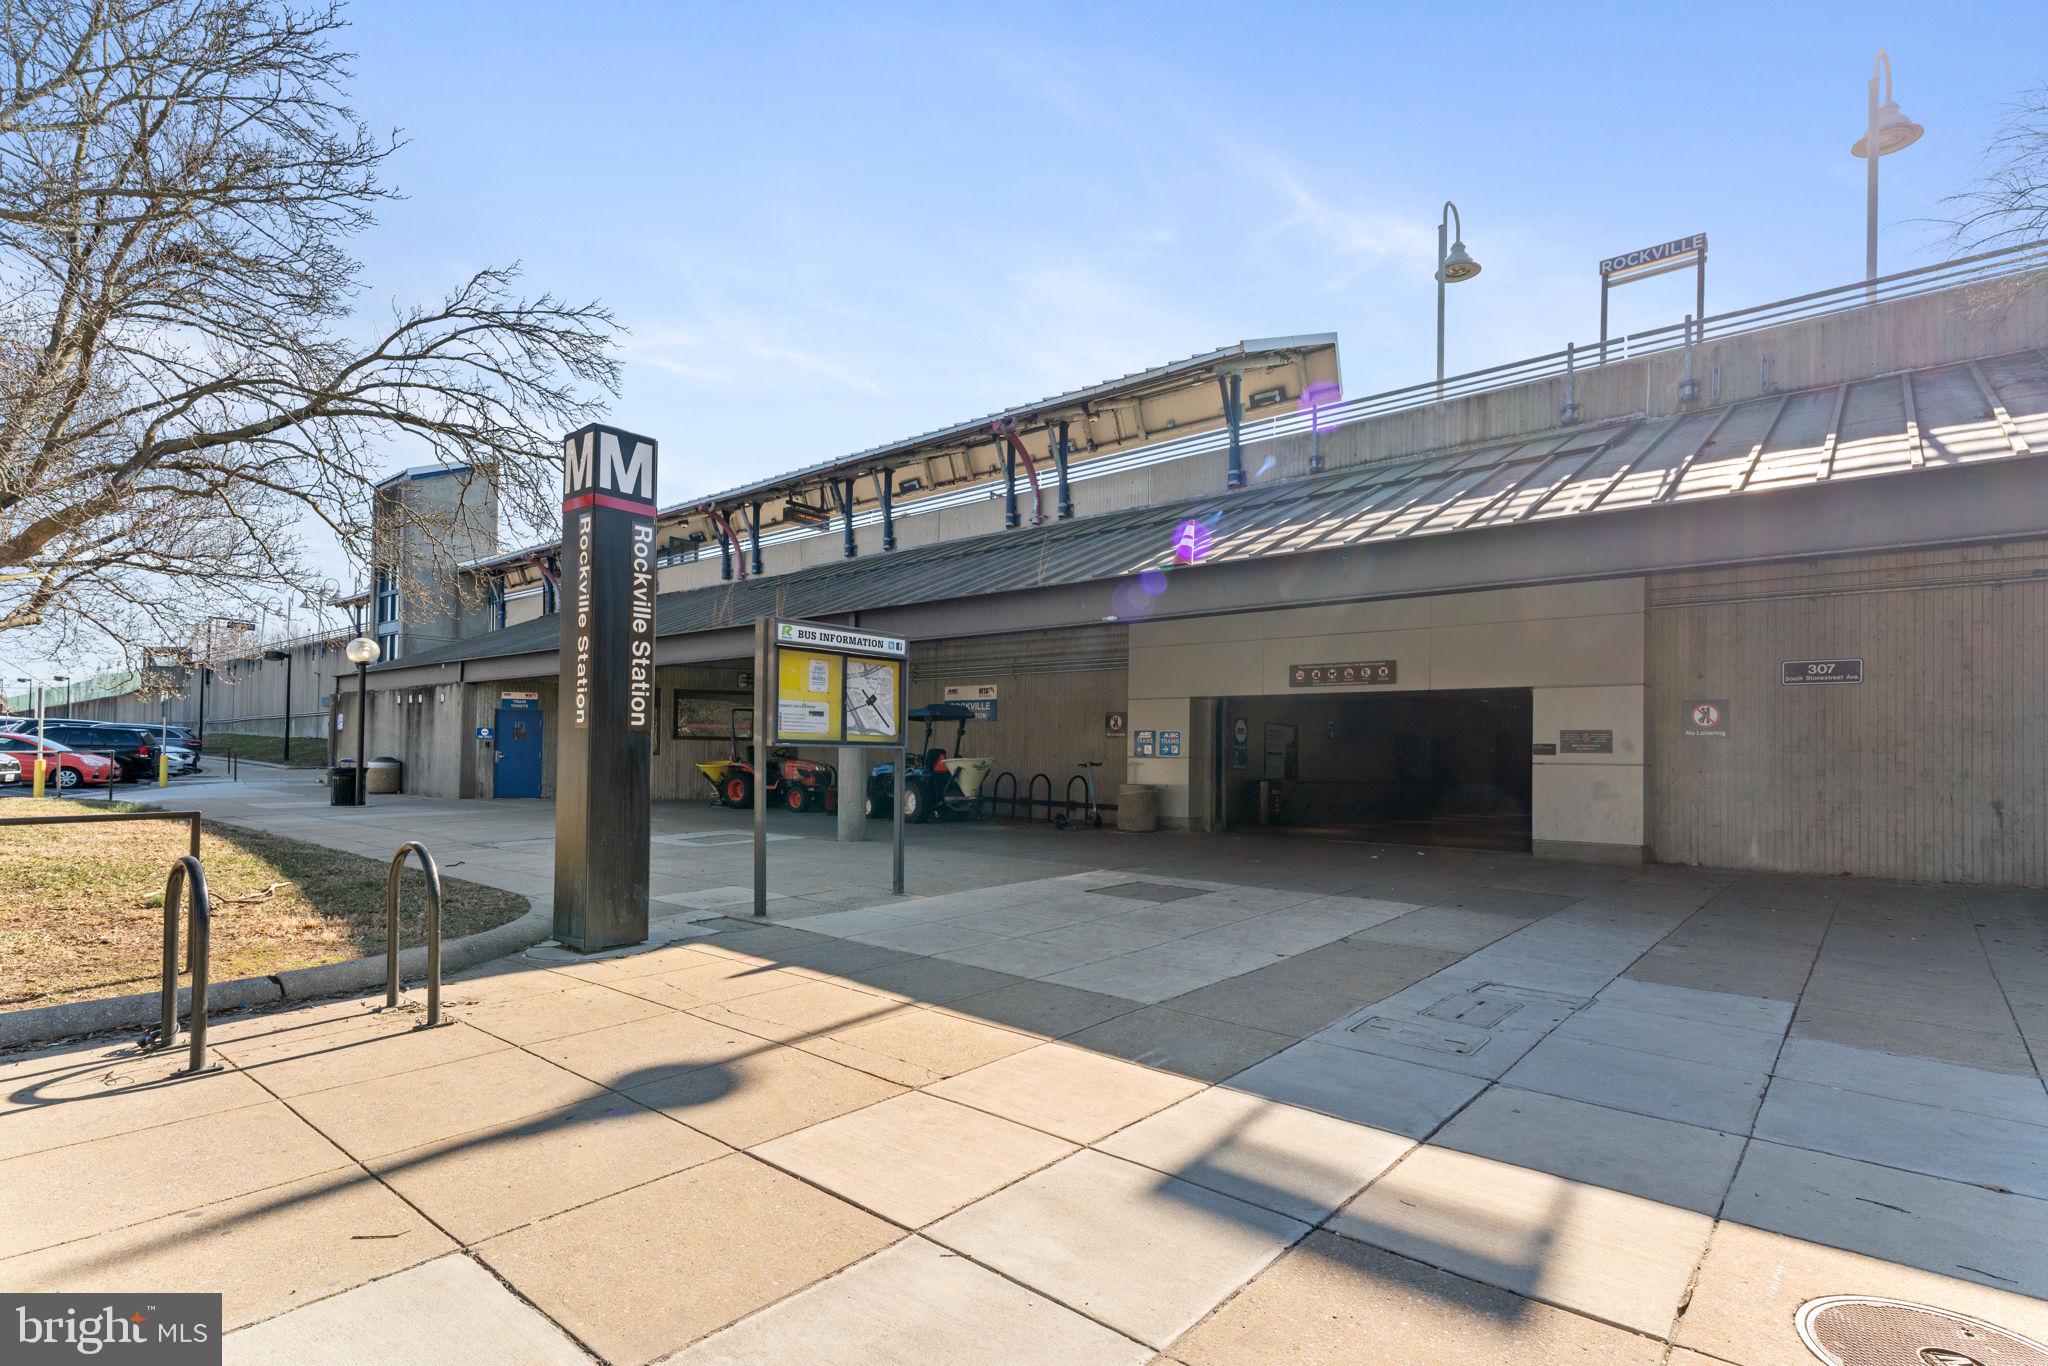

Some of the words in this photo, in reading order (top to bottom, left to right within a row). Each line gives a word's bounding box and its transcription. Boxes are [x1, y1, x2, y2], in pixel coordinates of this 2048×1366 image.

[1601, 234, 1704, 274] ROCKVILLE
[565, 431, 594, 495] M
[600, 432, 652, 499] M
[578, 516, 591, 628] Rockville
[632, 524, 653, 633] Rockville
[798, 629, 817, 641] BUS
[819, 632, 884, 649] INFORMATION
[1808, 664, 1836, 674] 307
[576, 636, 589, 723] Station
[630, 640, 651, 726] Station
[1805, 674, 1844, 682] Stonestreet
